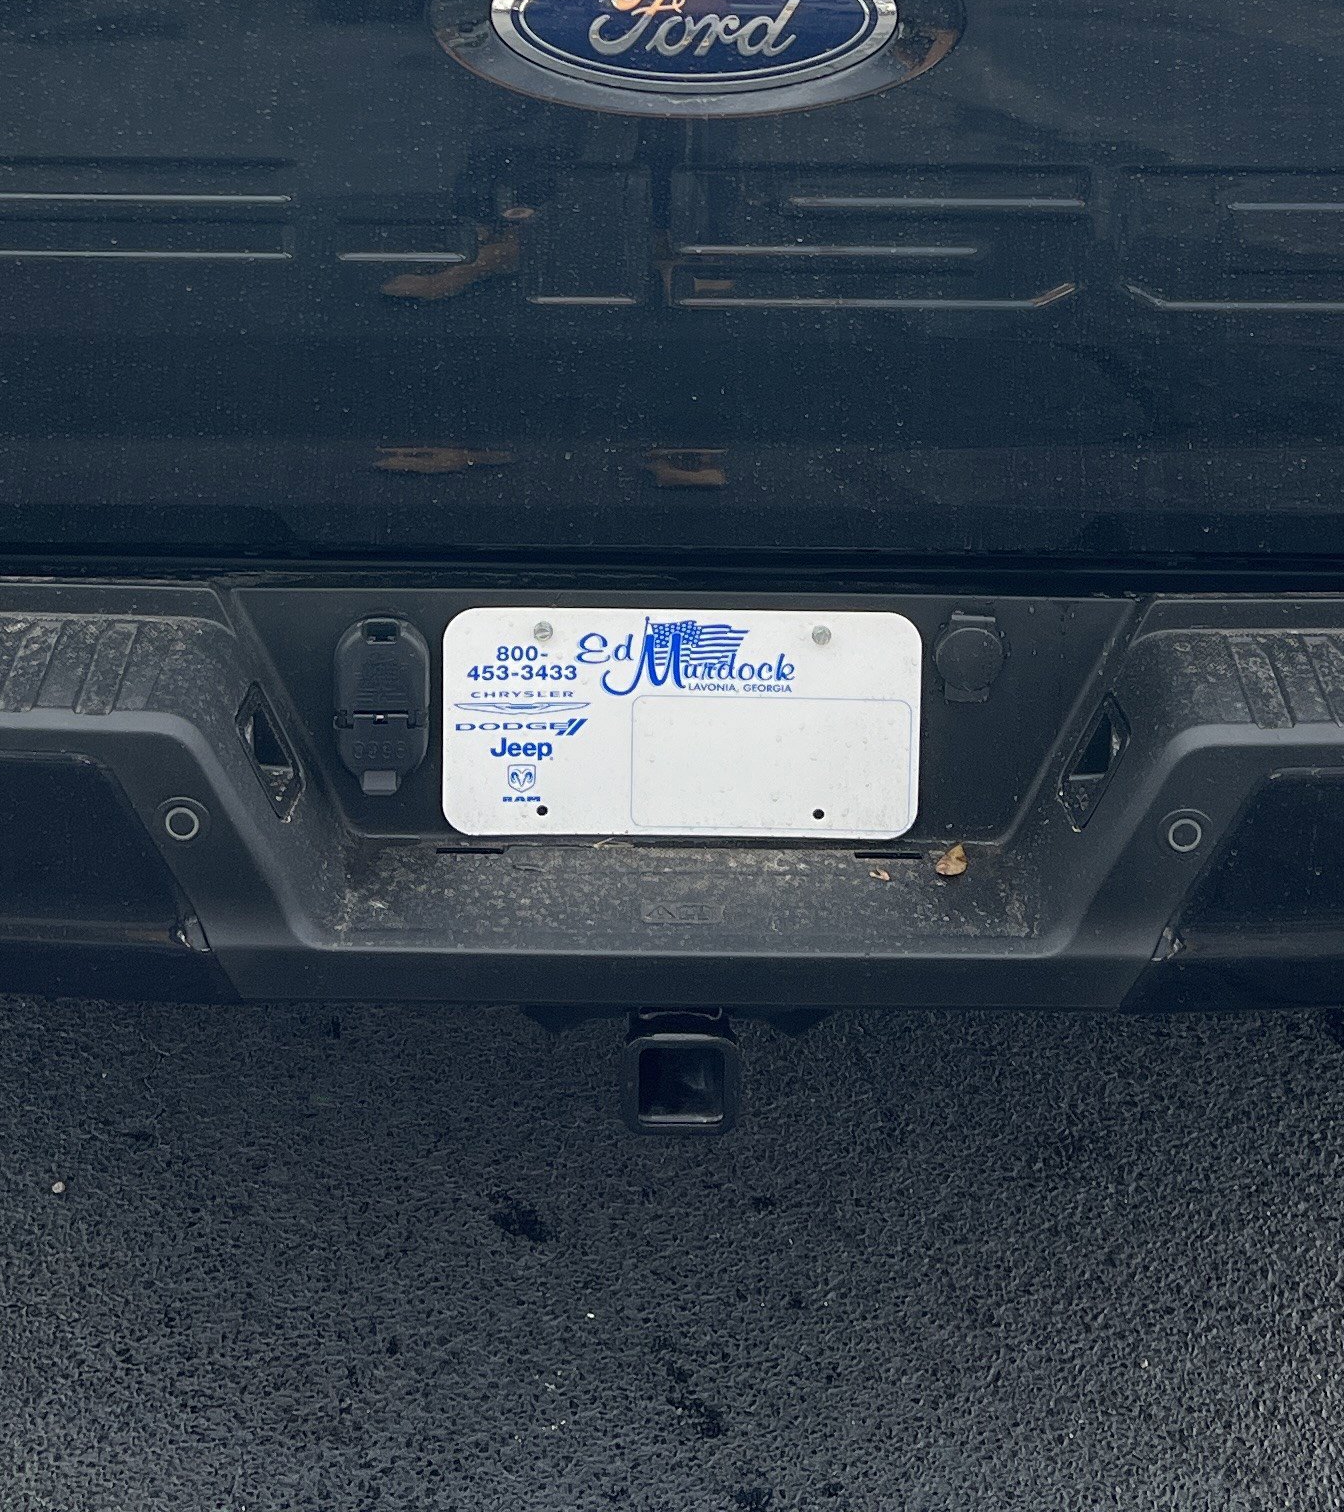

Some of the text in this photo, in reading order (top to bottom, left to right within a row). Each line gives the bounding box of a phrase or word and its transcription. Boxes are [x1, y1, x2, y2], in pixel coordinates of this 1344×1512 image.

[496, 645, 548, 662] 800-
[574, 632, 795, 696] Ed Murdock
[467, 664, 577, 681] 453-3433
[470, 690, 574, 699] CHRYSLER
[743, 683, 793, 694] GEORGIA
[455, 721, 569, 732] DODGE
[490, 737, 553, 761] Jeep
[502, 795, 541, 803] RAM
